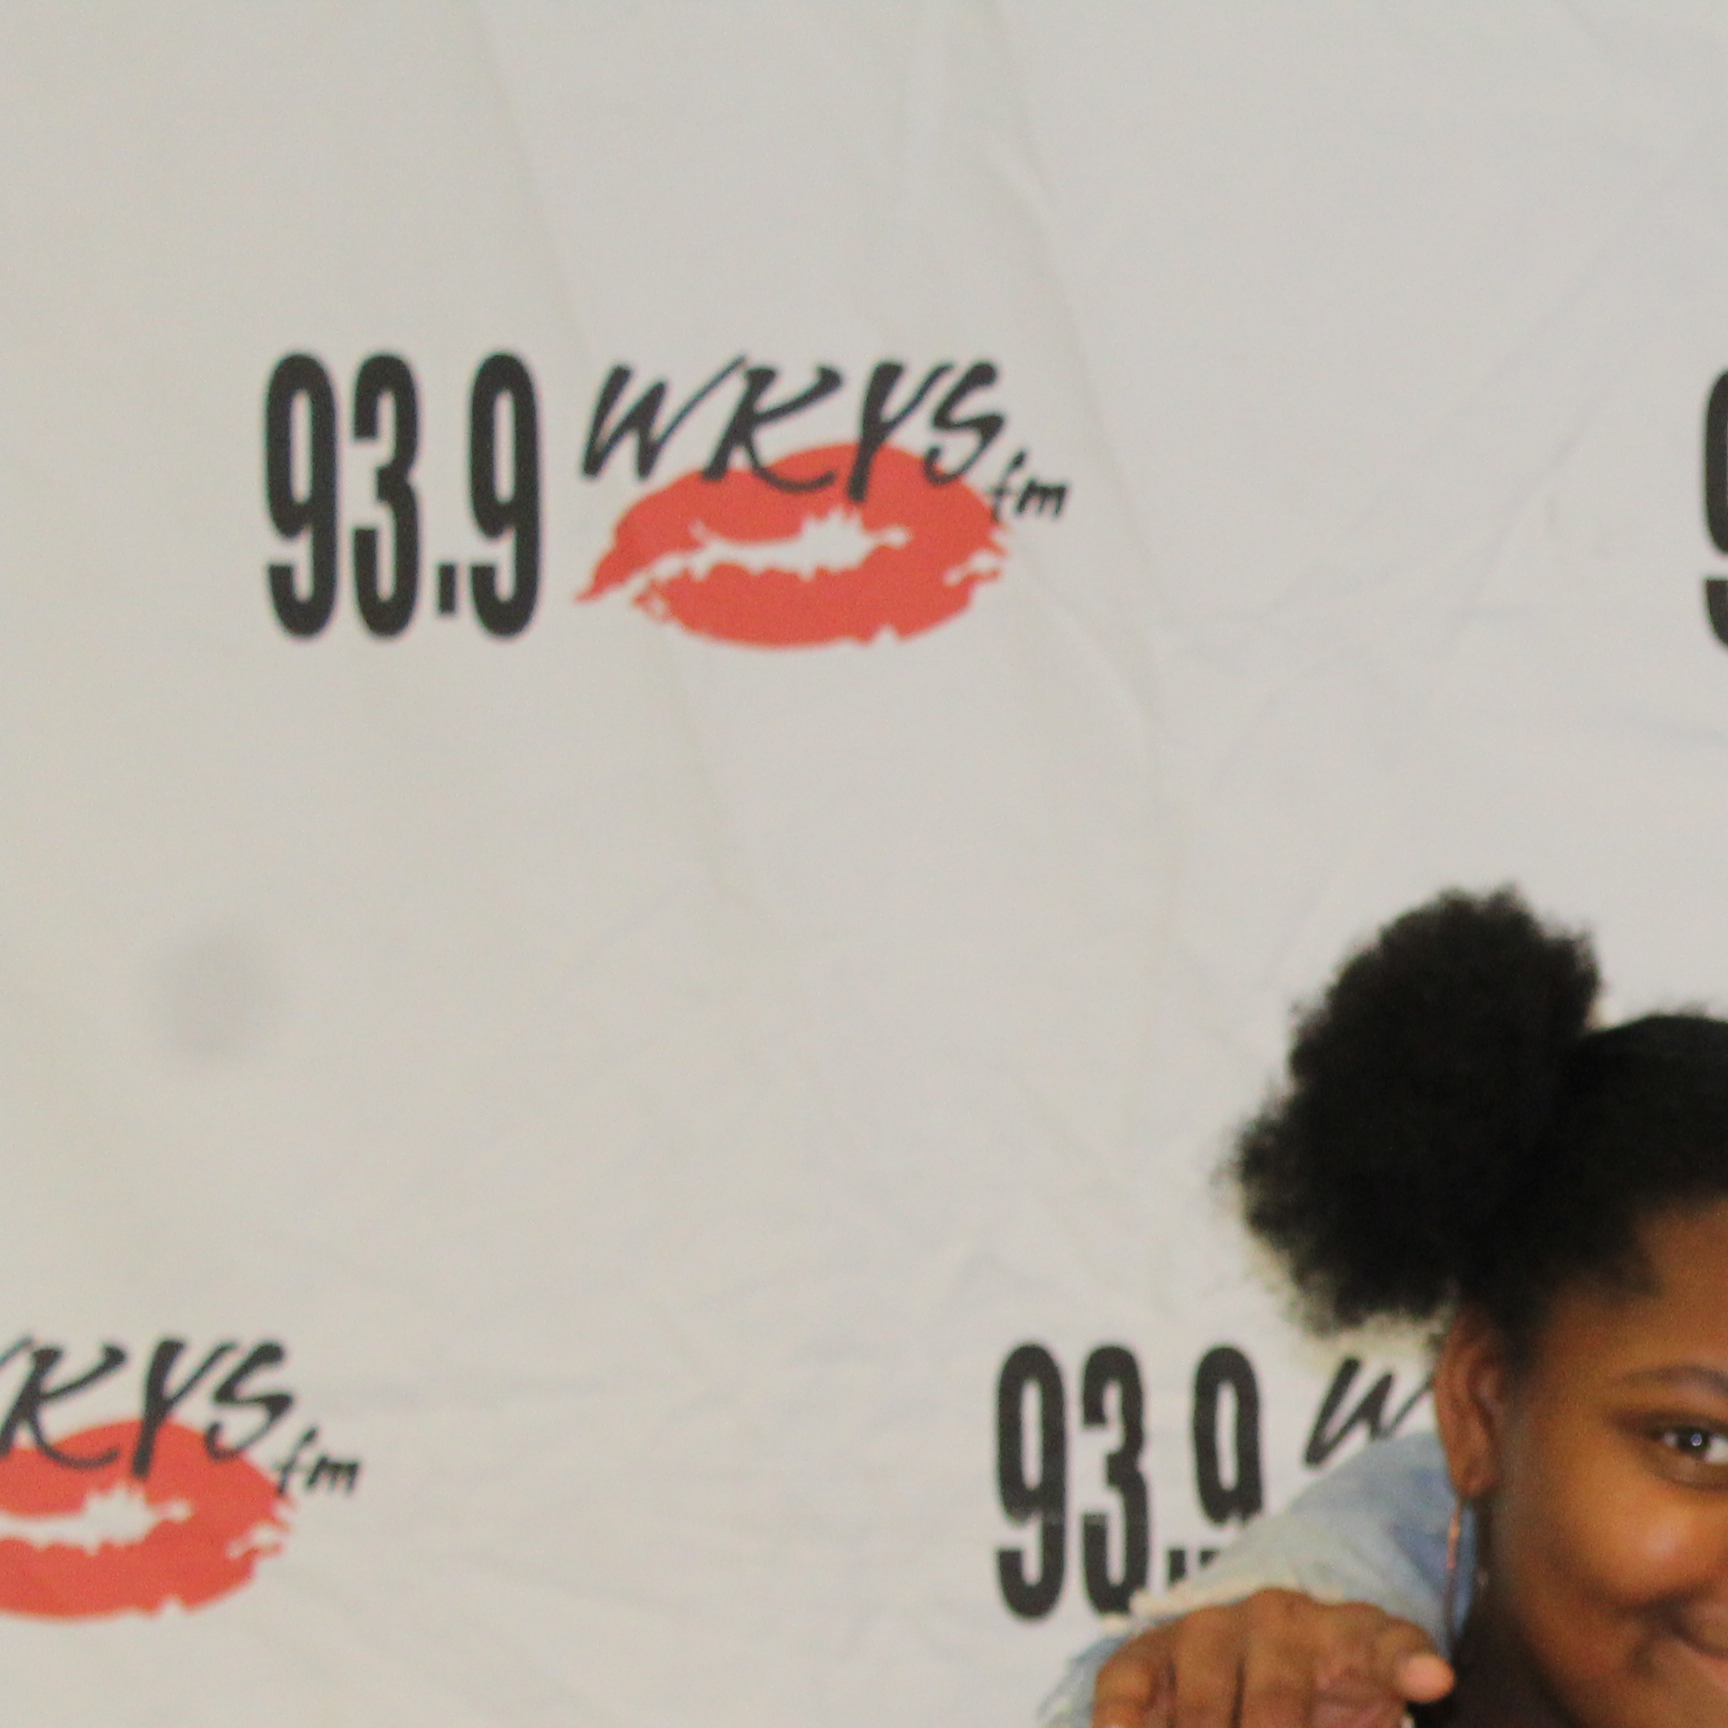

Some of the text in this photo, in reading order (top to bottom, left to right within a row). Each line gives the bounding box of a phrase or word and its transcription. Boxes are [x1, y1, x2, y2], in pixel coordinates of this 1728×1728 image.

[263, 352, 542, 639] 93.9
[581, 355, 1006, 503] WKYS
[0, 1337, 295, 1480] KYS
[995, 1342, 1266, 1622] 93.9
